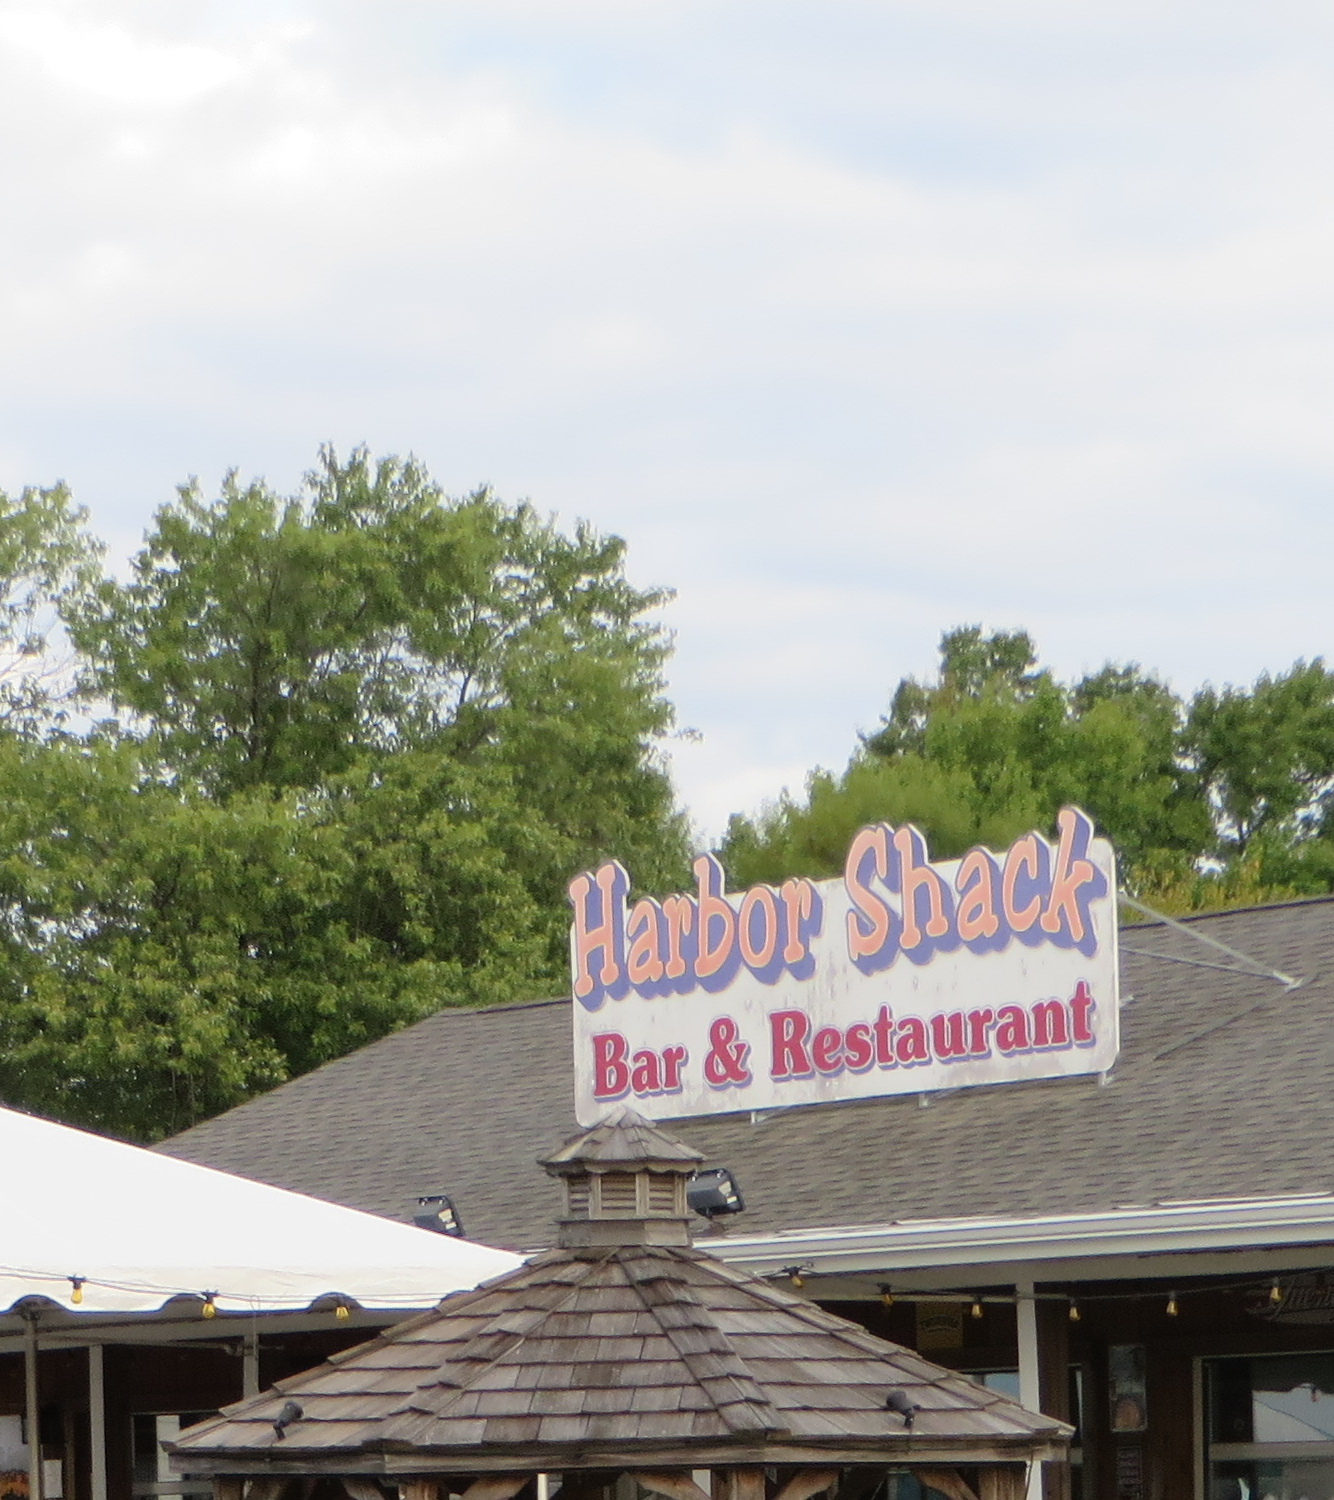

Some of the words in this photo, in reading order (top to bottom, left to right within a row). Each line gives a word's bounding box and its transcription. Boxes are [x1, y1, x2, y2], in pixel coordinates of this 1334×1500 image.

[569, 852, 824, 1011] Harbor
[844, 806, 1108, 975] Shack
[592, 1032, 688, 1098] Bar
[704, 1016, 750, 1086] &
[769, 980, 1096, 1082] Restaurant
